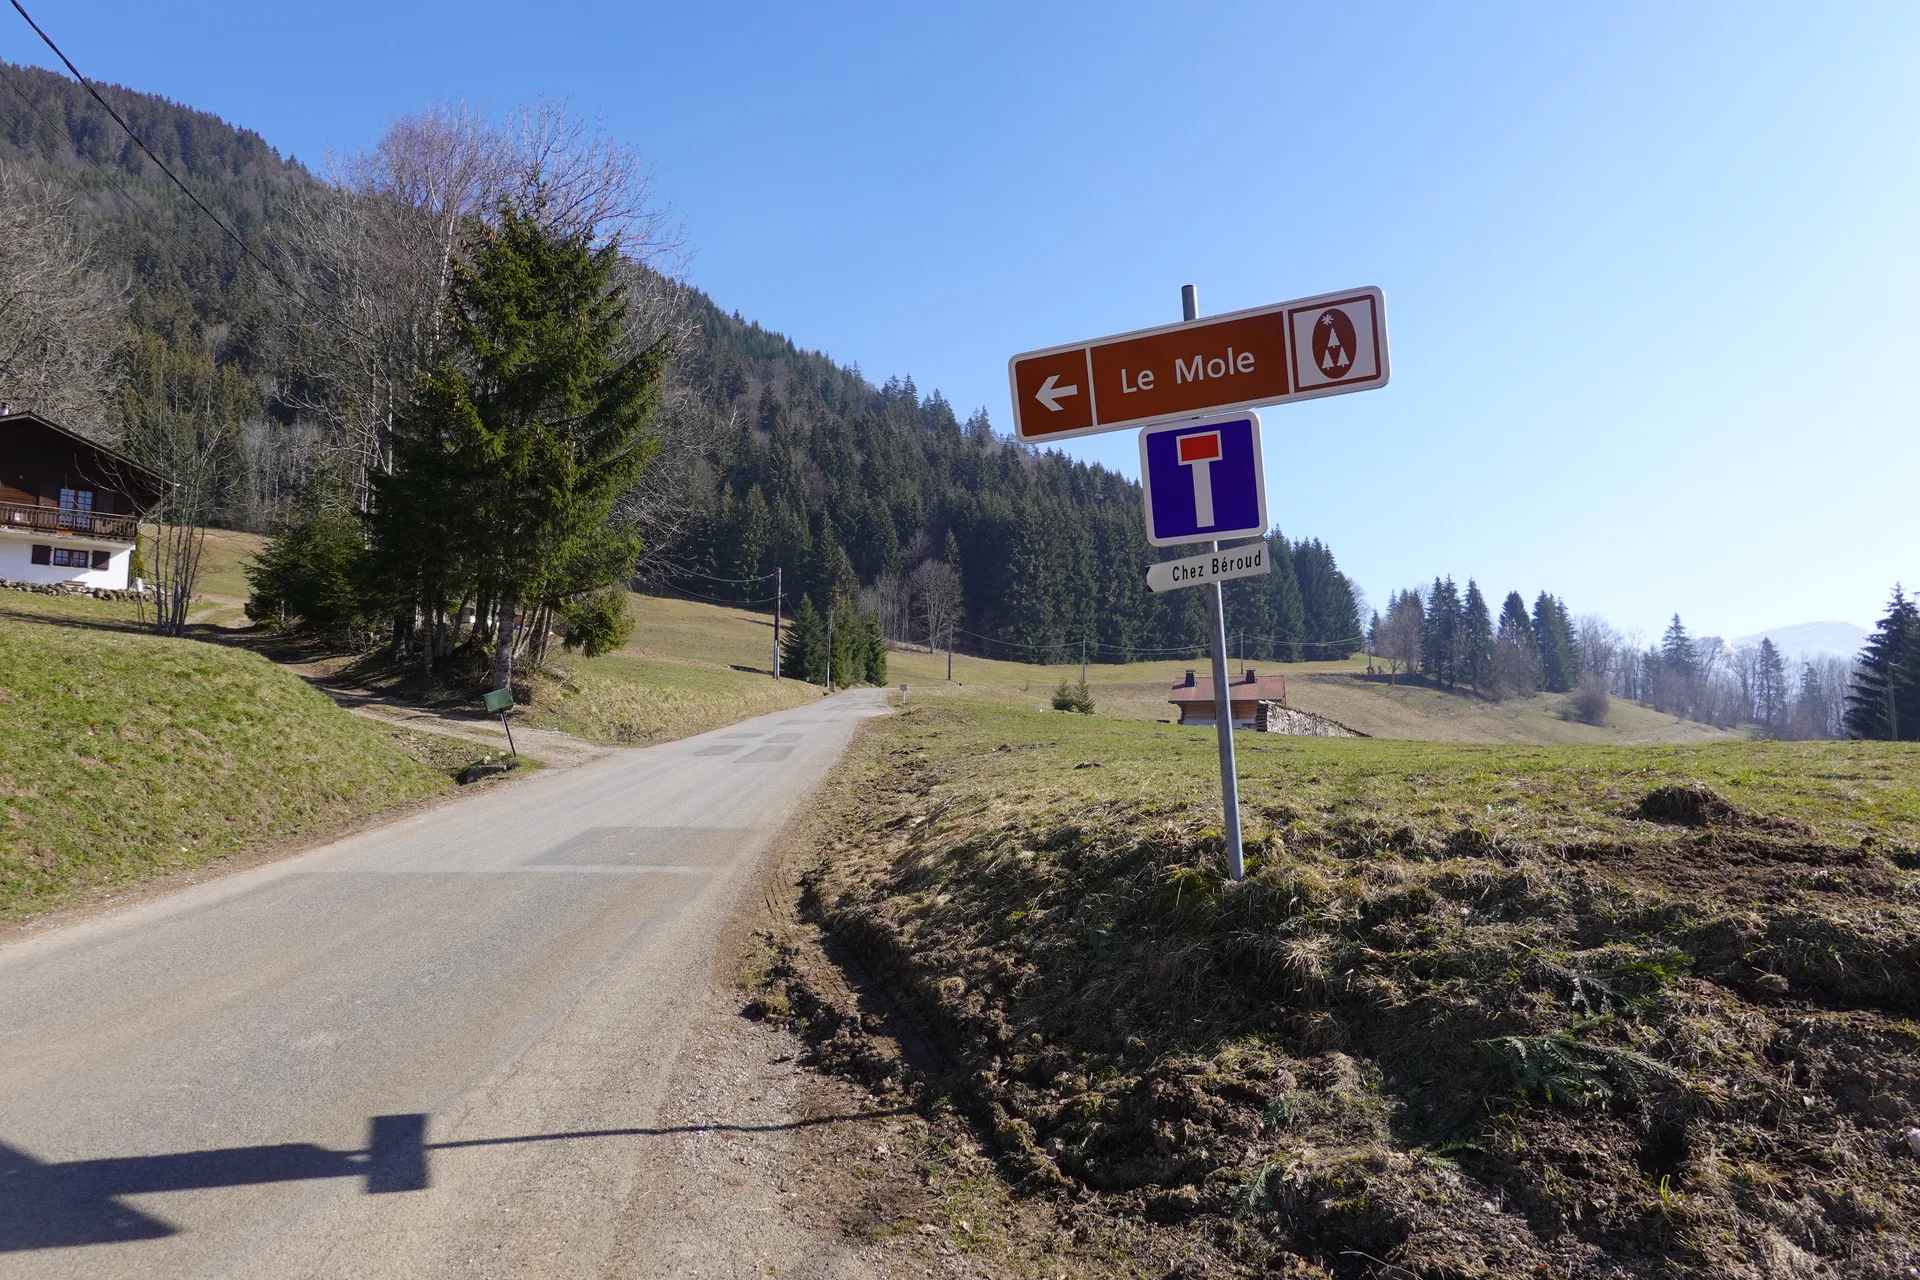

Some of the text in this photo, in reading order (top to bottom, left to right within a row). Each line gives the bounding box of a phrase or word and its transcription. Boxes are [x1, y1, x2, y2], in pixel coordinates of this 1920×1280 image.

[1121, 347, 1255, 394] Le Mole
[1172, 550, 1262, 583] Chez Béroud
